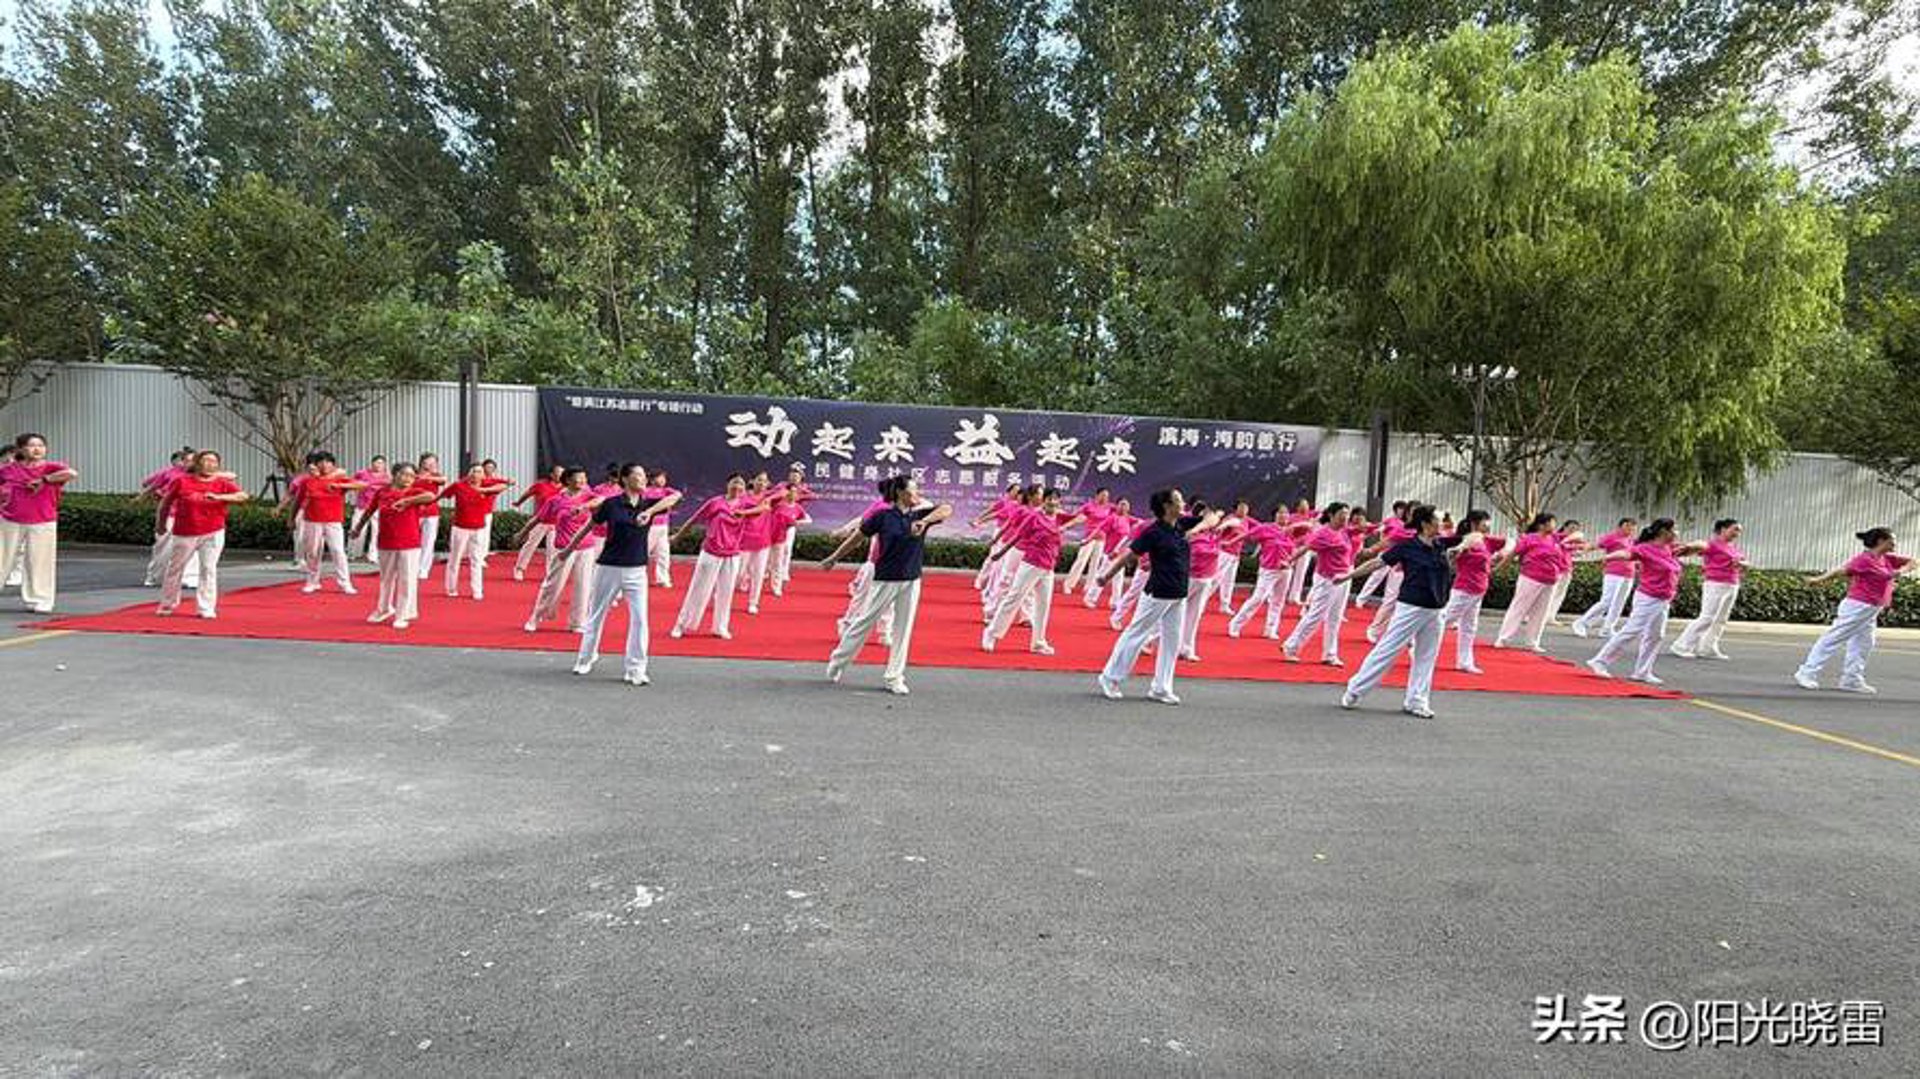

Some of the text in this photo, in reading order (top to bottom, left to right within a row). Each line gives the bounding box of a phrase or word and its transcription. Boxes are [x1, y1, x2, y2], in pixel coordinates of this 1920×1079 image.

[724, 405, 1137, 474] 动起来 益起来
